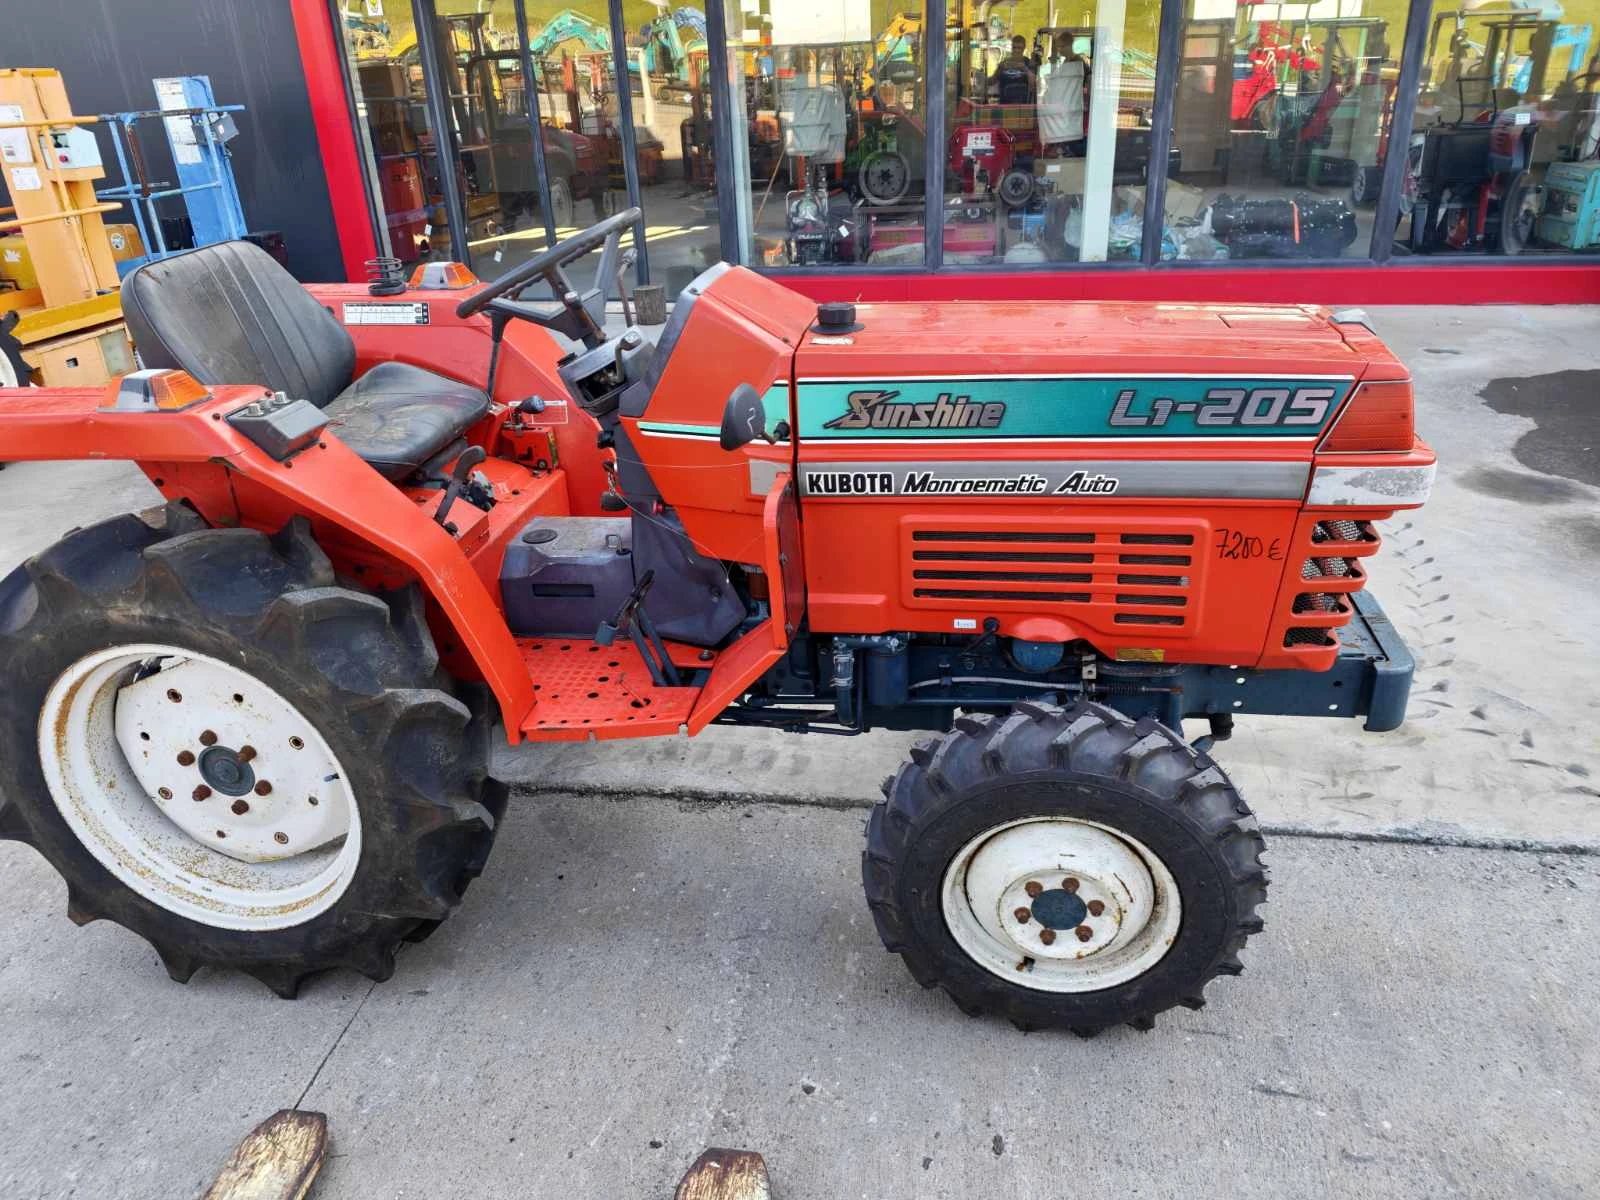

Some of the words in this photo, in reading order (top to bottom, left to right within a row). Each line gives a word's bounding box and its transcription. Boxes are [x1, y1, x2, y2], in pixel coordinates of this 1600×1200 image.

[824, 390, 1006, 429] Sunshine
[806, 471, 894, 494] KUBOTA
[902, 471, 1048, 495] Monroematic
[1053, 470, 1120, 495] Auto
